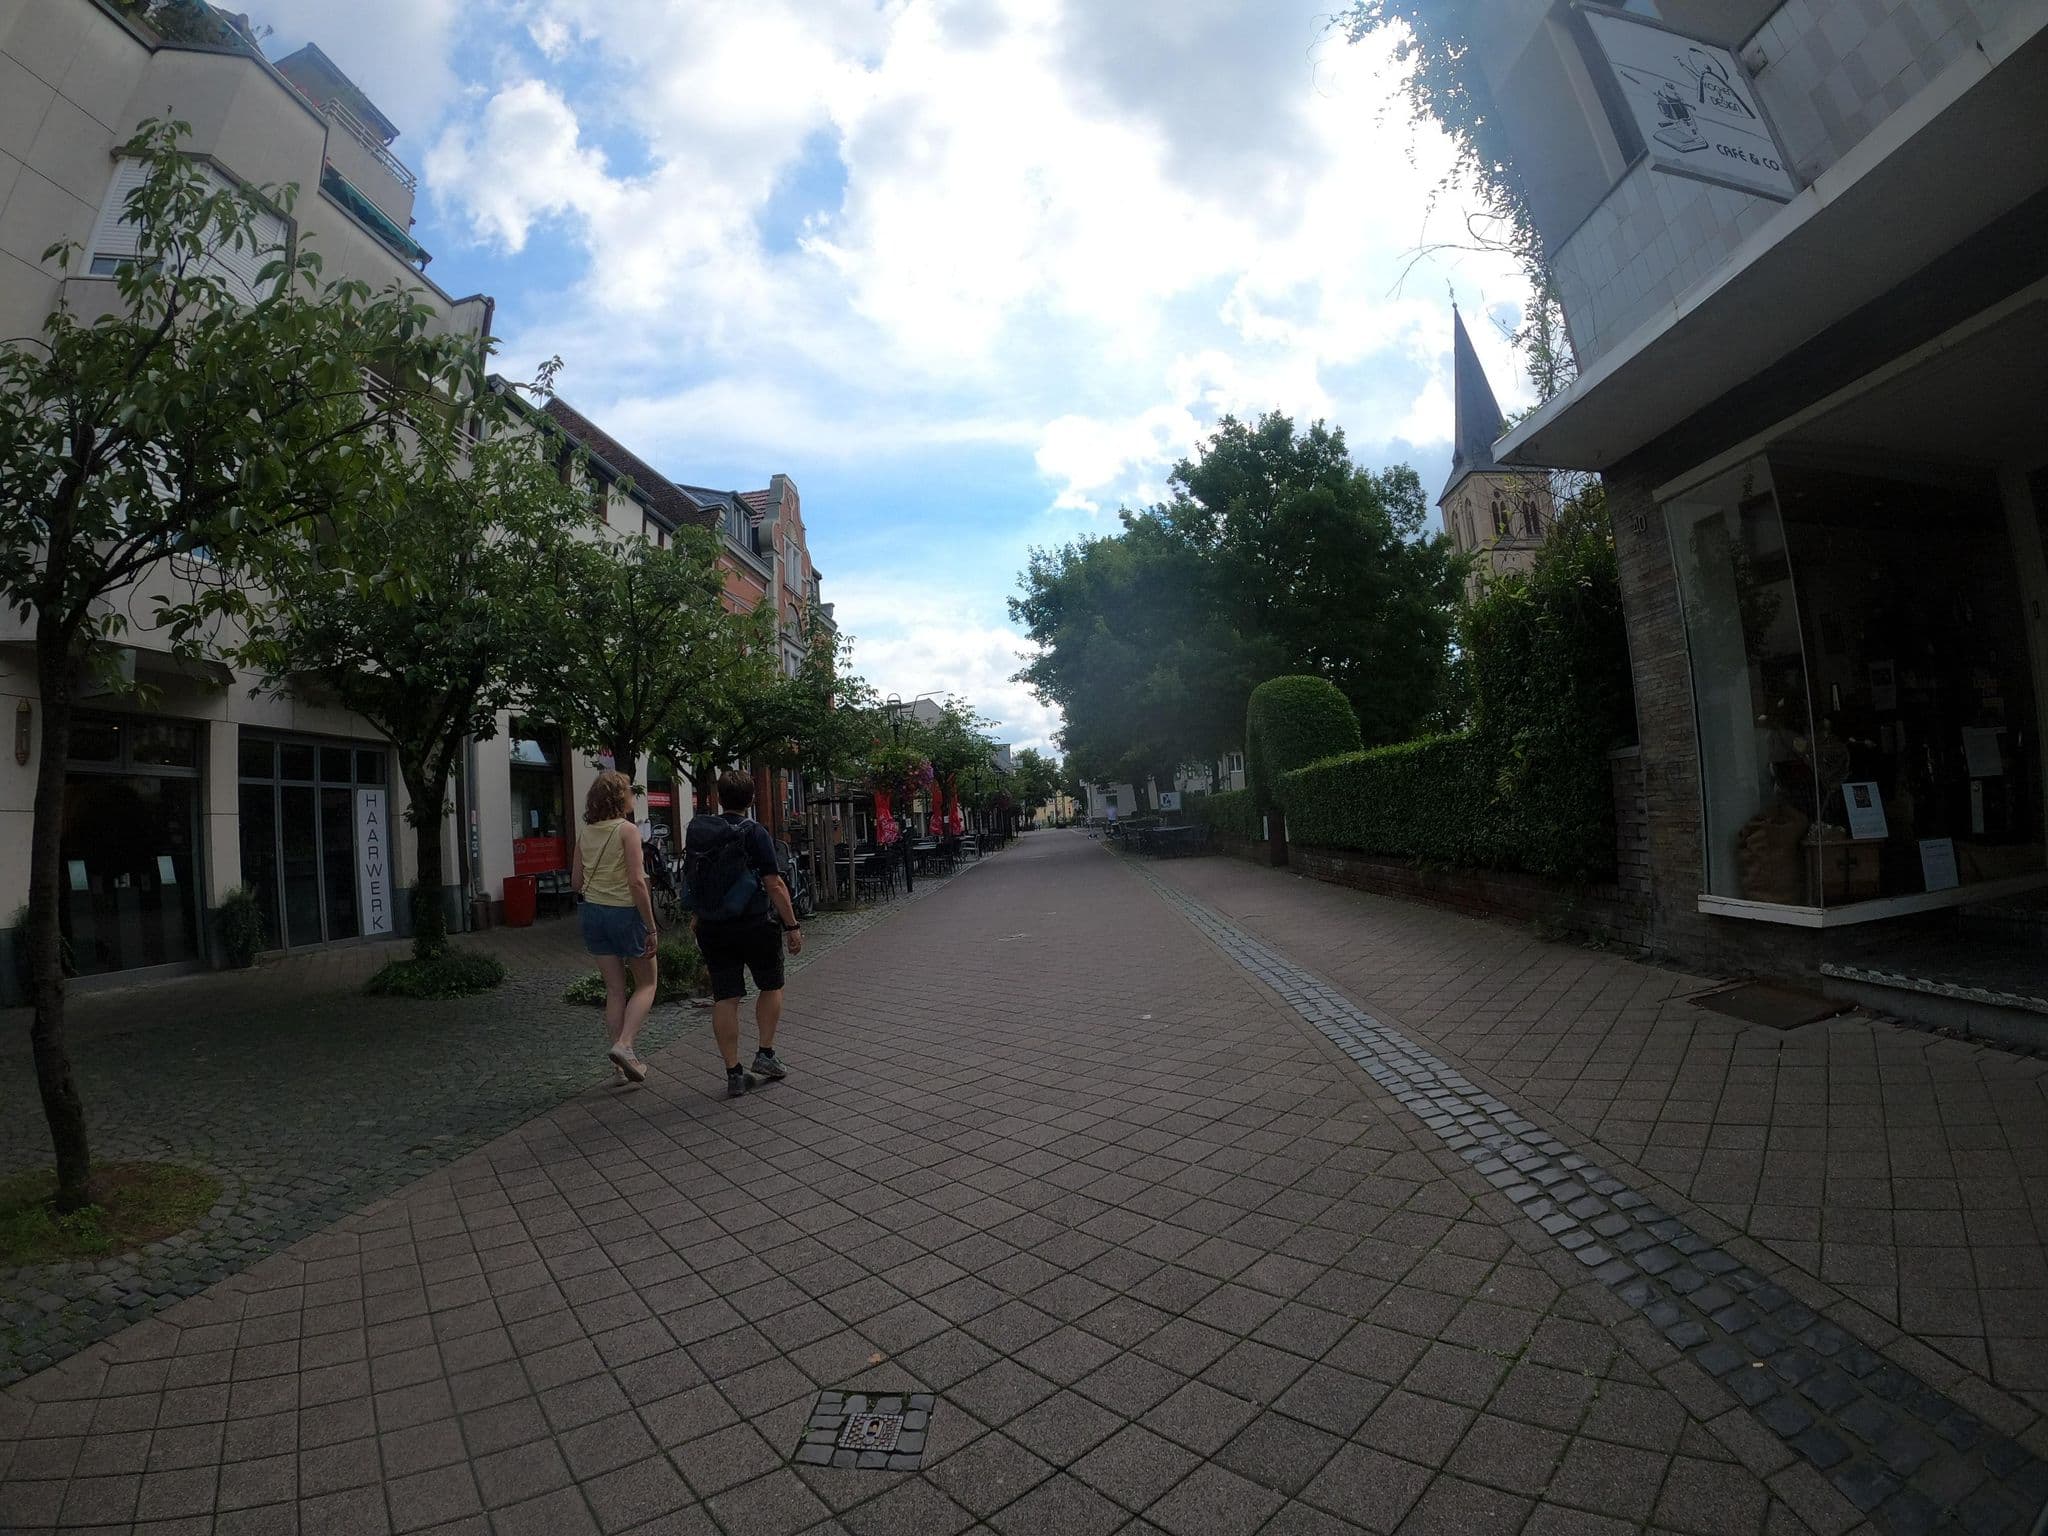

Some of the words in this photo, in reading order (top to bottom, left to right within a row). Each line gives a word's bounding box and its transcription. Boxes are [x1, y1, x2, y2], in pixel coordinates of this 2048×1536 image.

[1749, 152, 1760, 166] &
[1763, 157, 1779, 171] CO
[366, 794, 383, 930] HAARWERK
